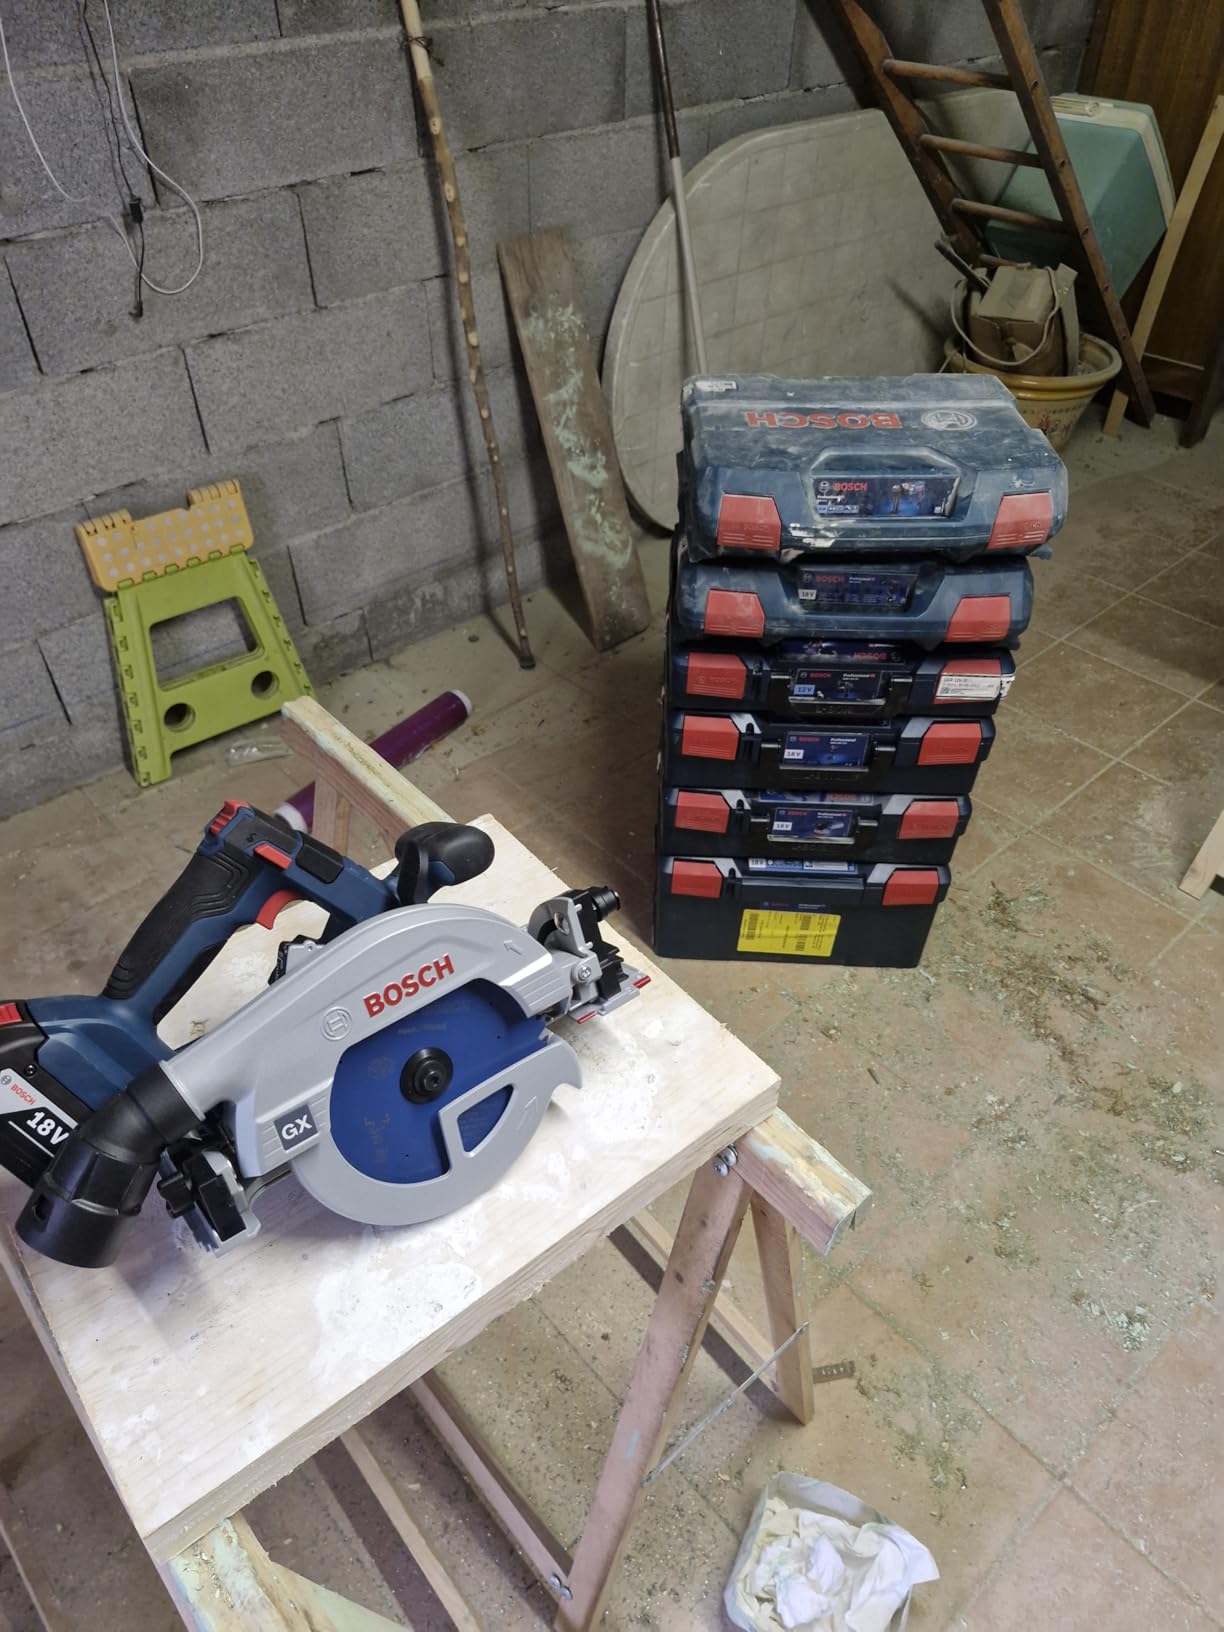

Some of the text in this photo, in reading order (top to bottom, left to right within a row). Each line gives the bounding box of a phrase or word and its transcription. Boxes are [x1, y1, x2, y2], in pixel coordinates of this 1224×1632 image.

[745, 411, 903, 429] BOSCH
[832, 482, 869, 492] BOSCH
[363, 953, 454, 1018] BOSCH
[11, 1083, 36, 1105] BOSCH
[26, 1111, 69, 1145] 18V
[281, 1113, 313, 1141] GX
